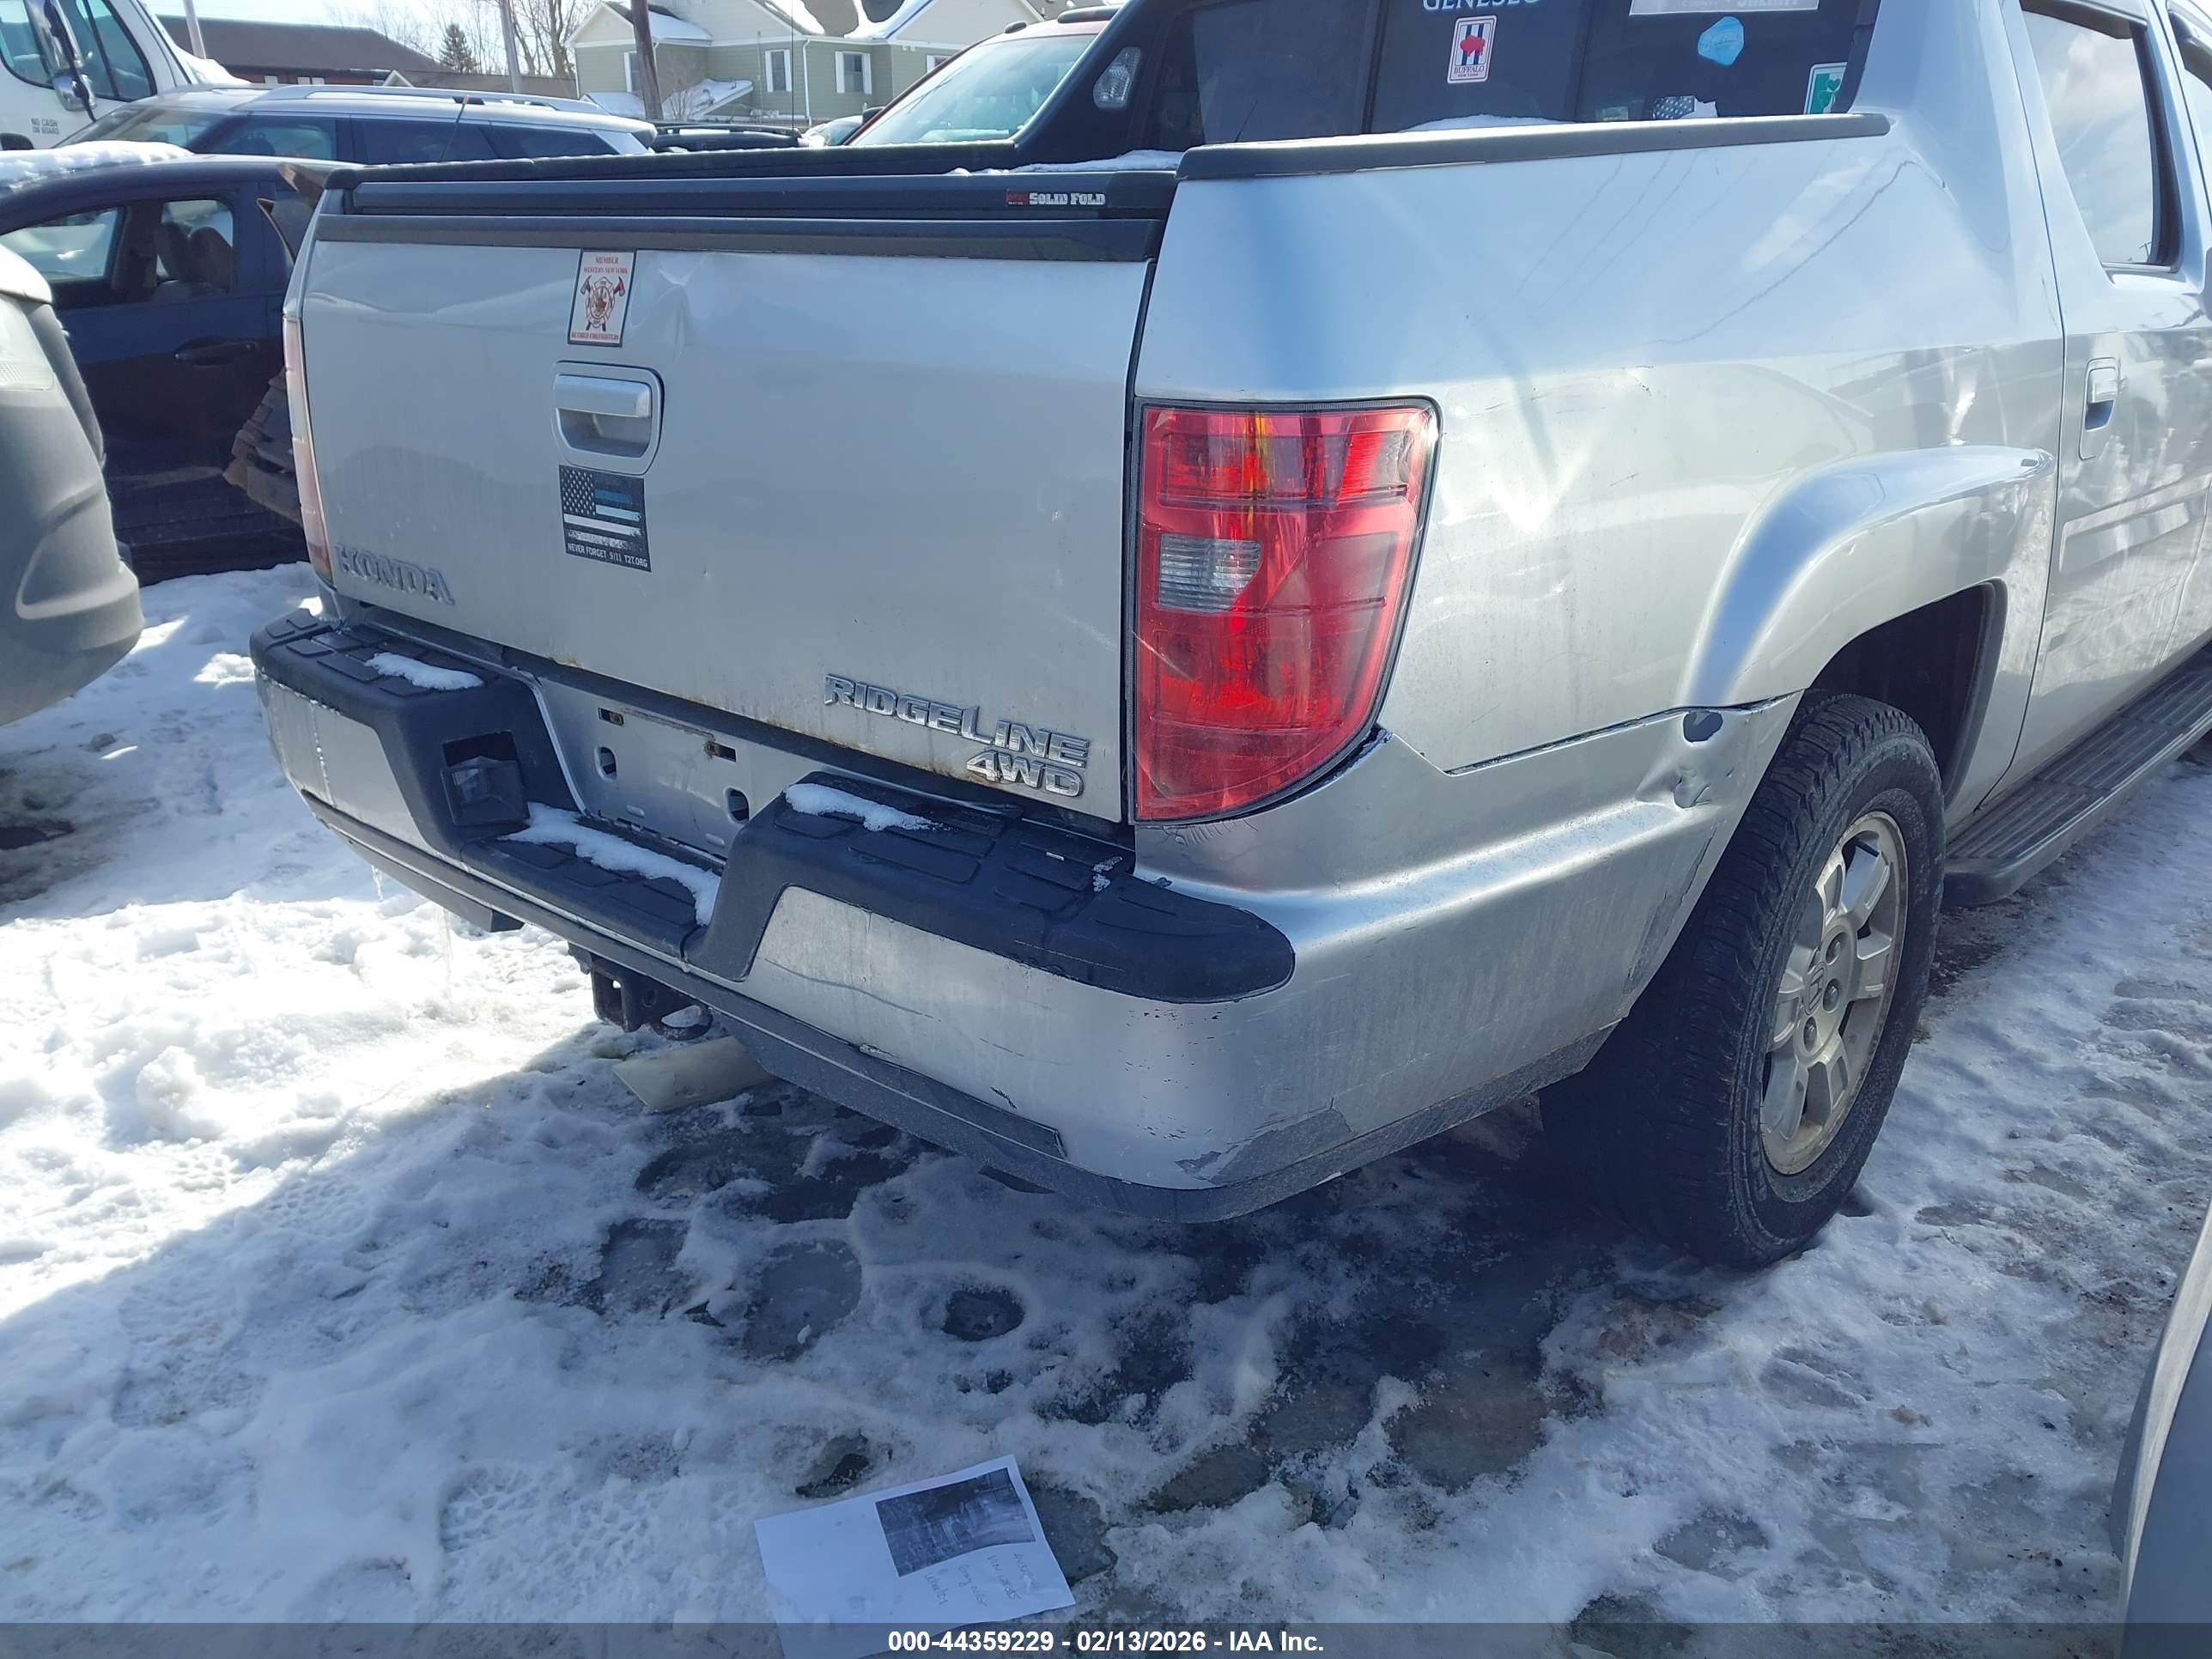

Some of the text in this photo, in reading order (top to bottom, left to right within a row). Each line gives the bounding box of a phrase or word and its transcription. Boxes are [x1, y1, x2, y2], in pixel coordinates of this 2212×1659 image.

[1454, 65, 1486, 74] BUFFALO
[1029, 192, 1068, 205] SOLID
[1070, 192, 1106, 205] FOLD
[568, 542, 586, 554] NEVER
[586, 546, 606, 559] FORGET
[609, 551, 622, 562] 9/11
[336, 543, 455, 605] HONDA
[824, 673, 1090, 769] RIDGELINE
[966, 749, 1084, 798] 4WD
